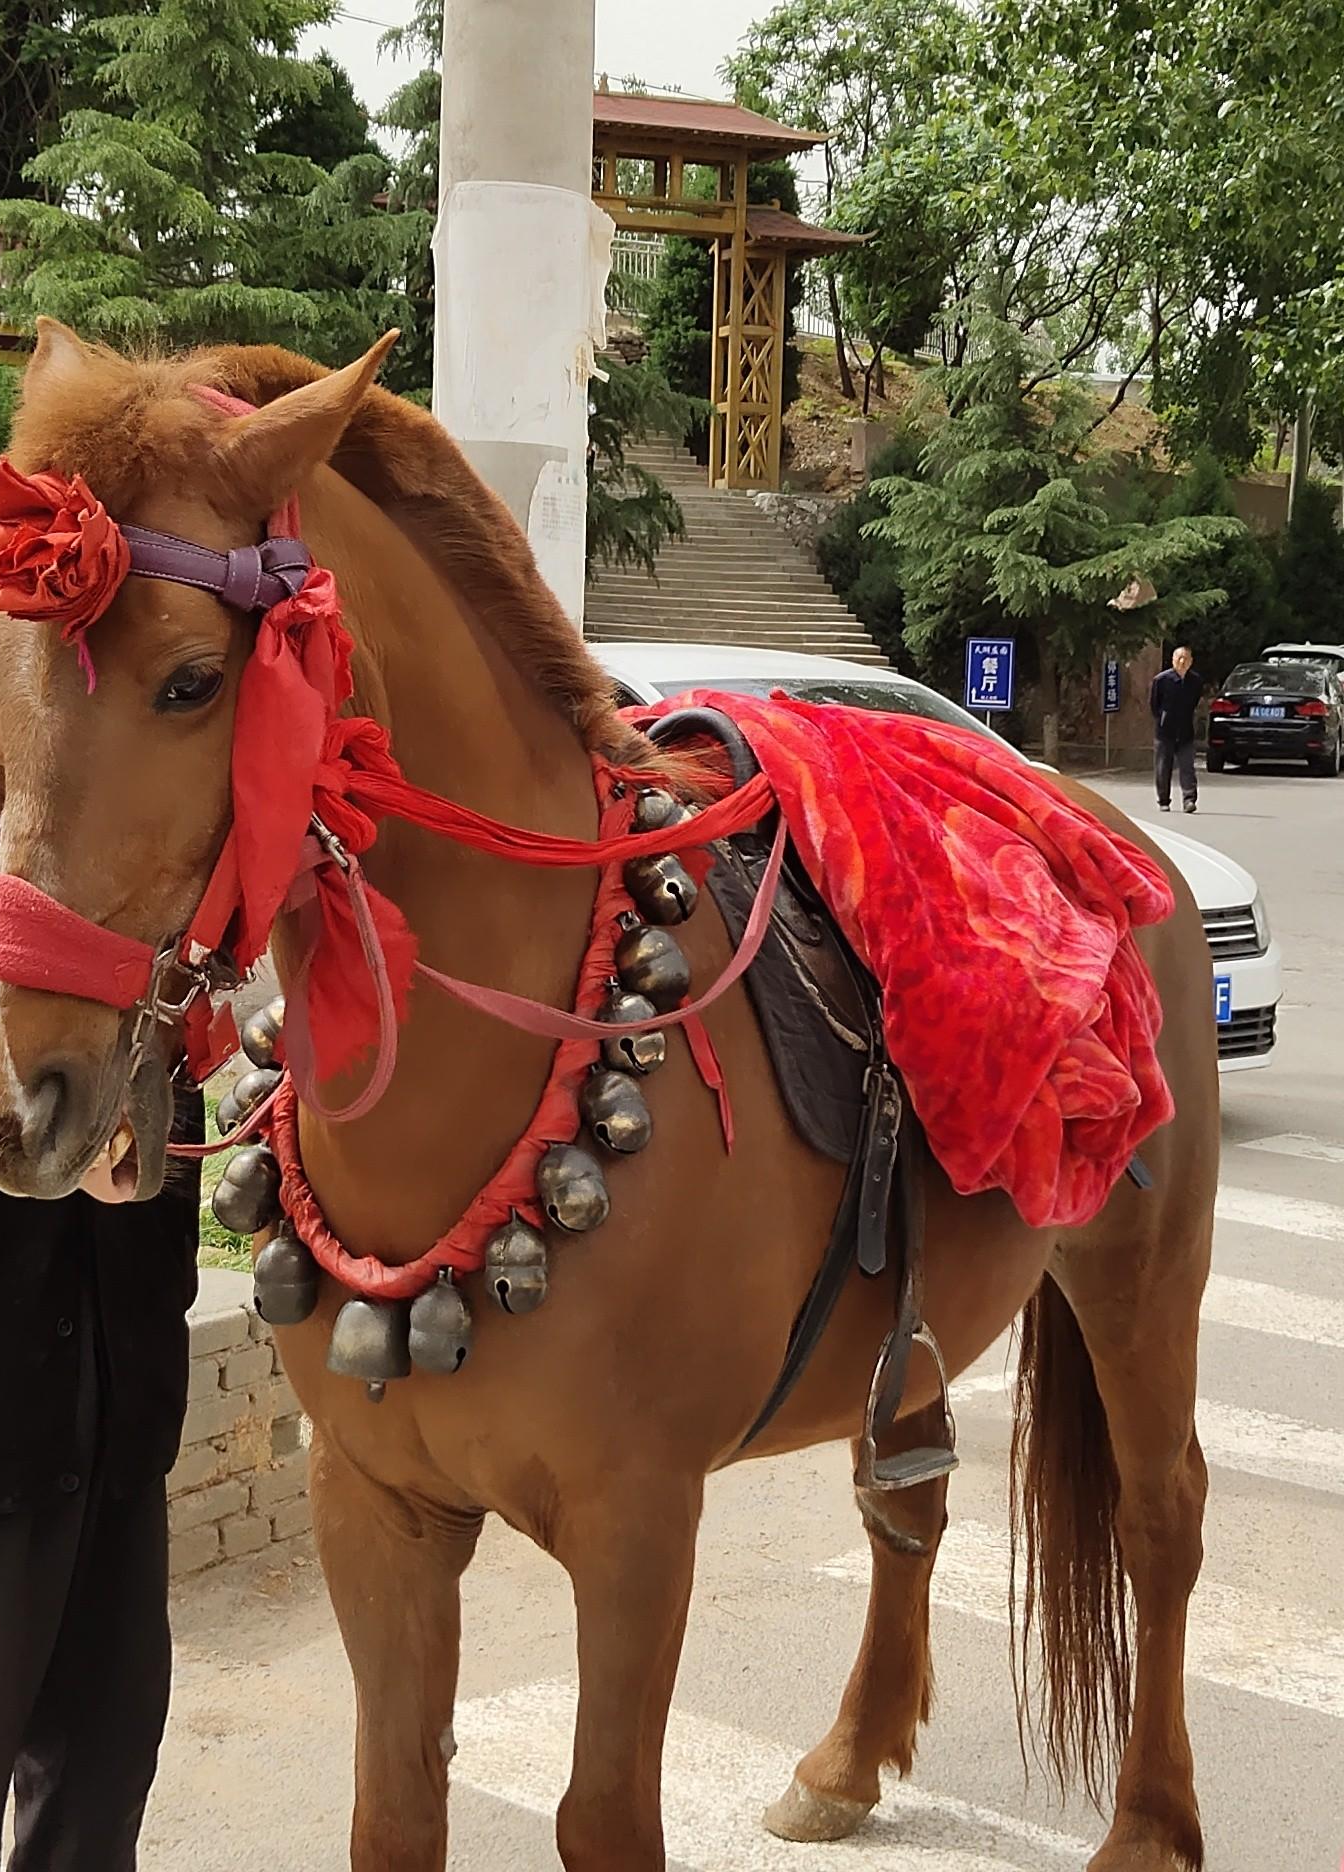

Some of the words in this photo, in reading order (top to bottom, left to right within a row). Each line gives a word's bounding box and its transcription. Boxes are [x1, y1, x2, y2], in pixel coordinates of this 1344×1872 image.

[981, 657, 998, 692] 餐厅
[1107, 660, 1117, 702] 停车场
